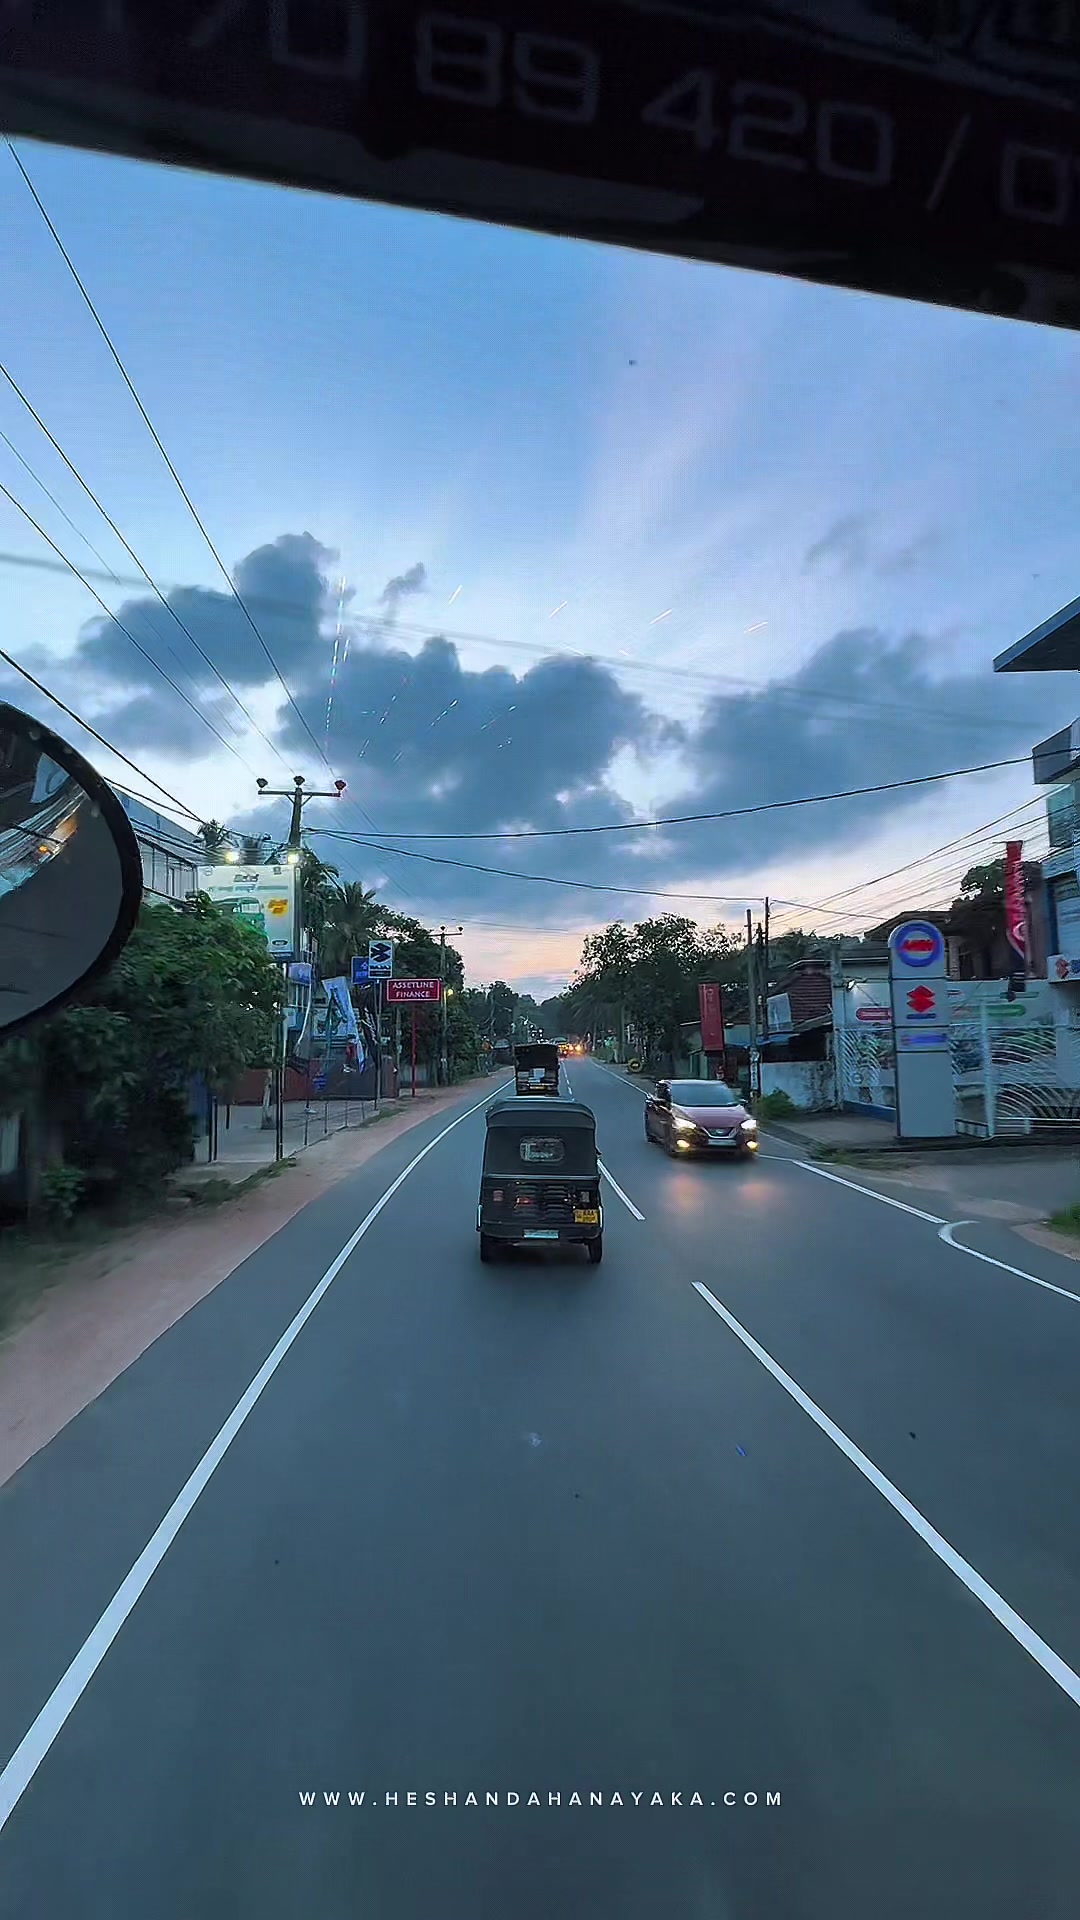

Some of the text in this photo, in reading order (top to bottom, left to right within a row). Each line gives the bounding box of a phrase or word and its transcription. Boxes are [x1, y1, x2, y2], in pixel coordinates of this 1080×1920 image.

[413, 10, 602, 127] 89
[641, 66, 896, 190] 420
[392, 981, 435, 989] ASSETLINE
